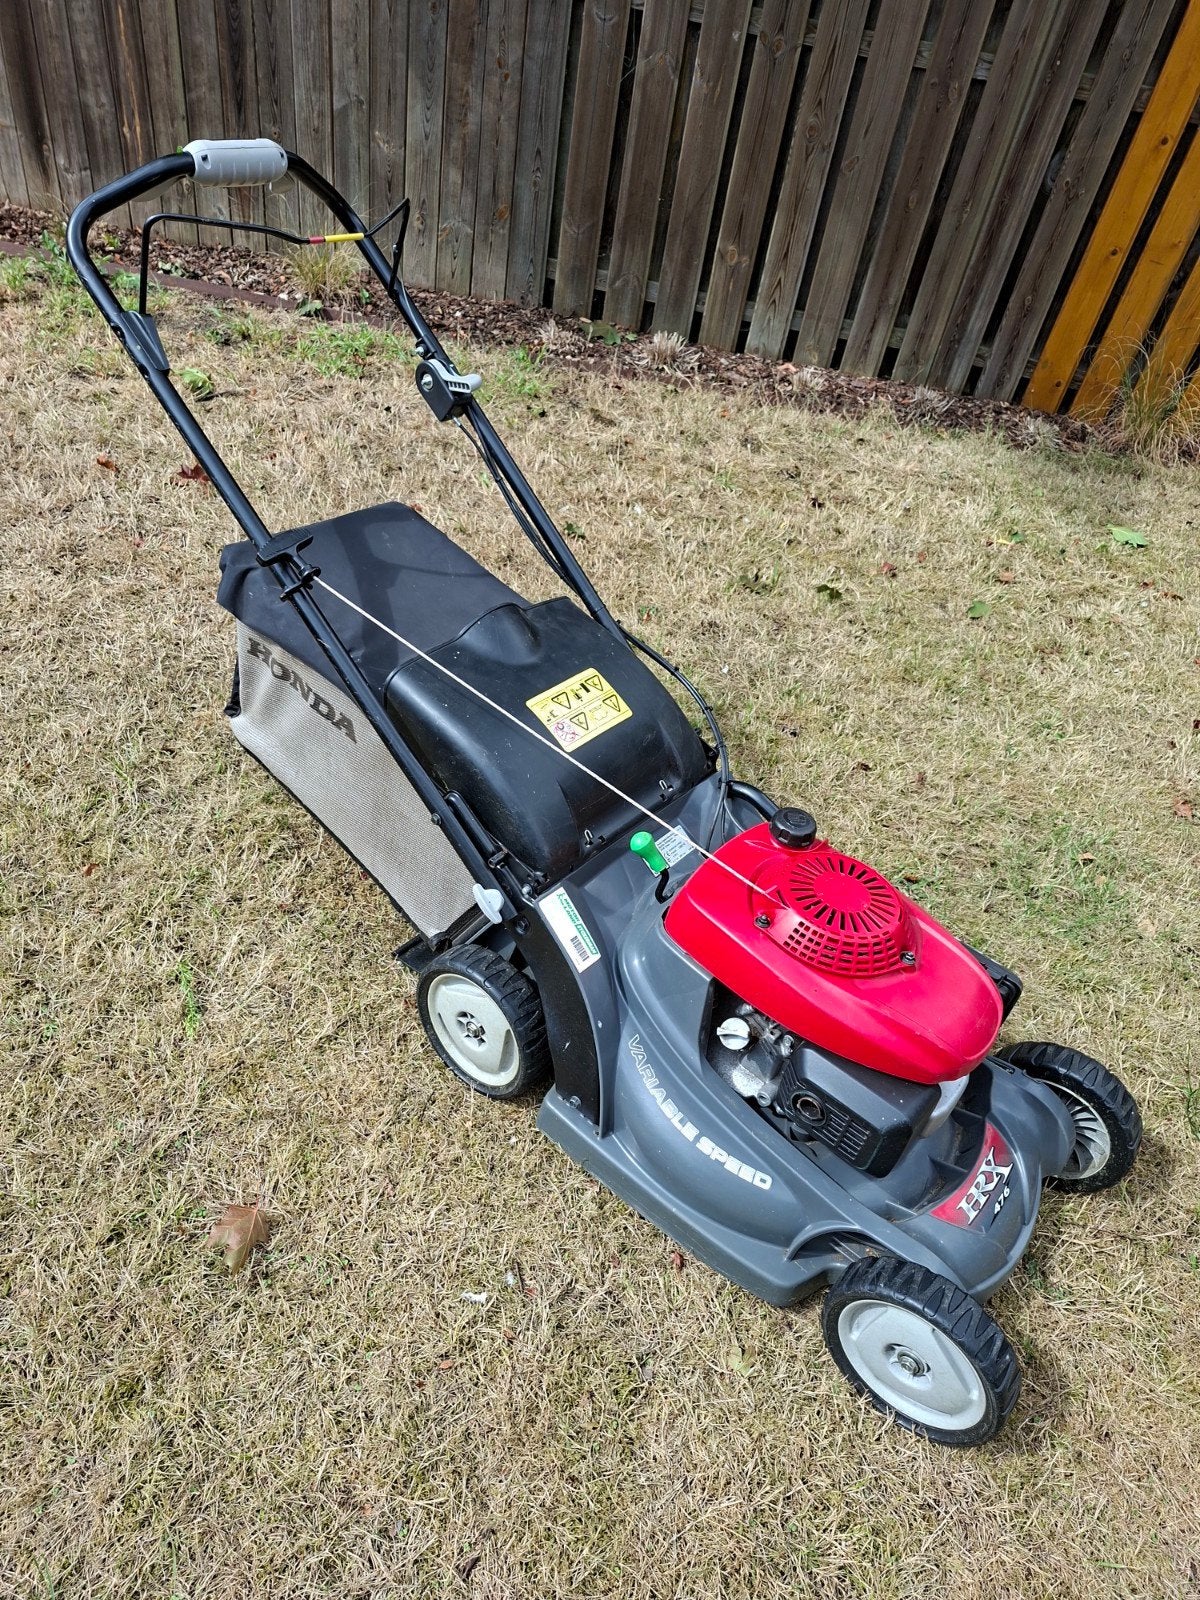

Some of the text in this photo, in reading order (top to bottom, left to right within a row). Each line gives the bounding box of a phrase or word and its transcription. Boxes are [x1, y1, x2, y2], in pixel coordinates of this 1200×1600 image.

[247, 638, 357, 743] HONDA
[628, 1034, 773, 1191] VARIABLE SPEED
[956, 1146, 1014, 1225] HRX
[994, 1185, 1011, 1214] 476
